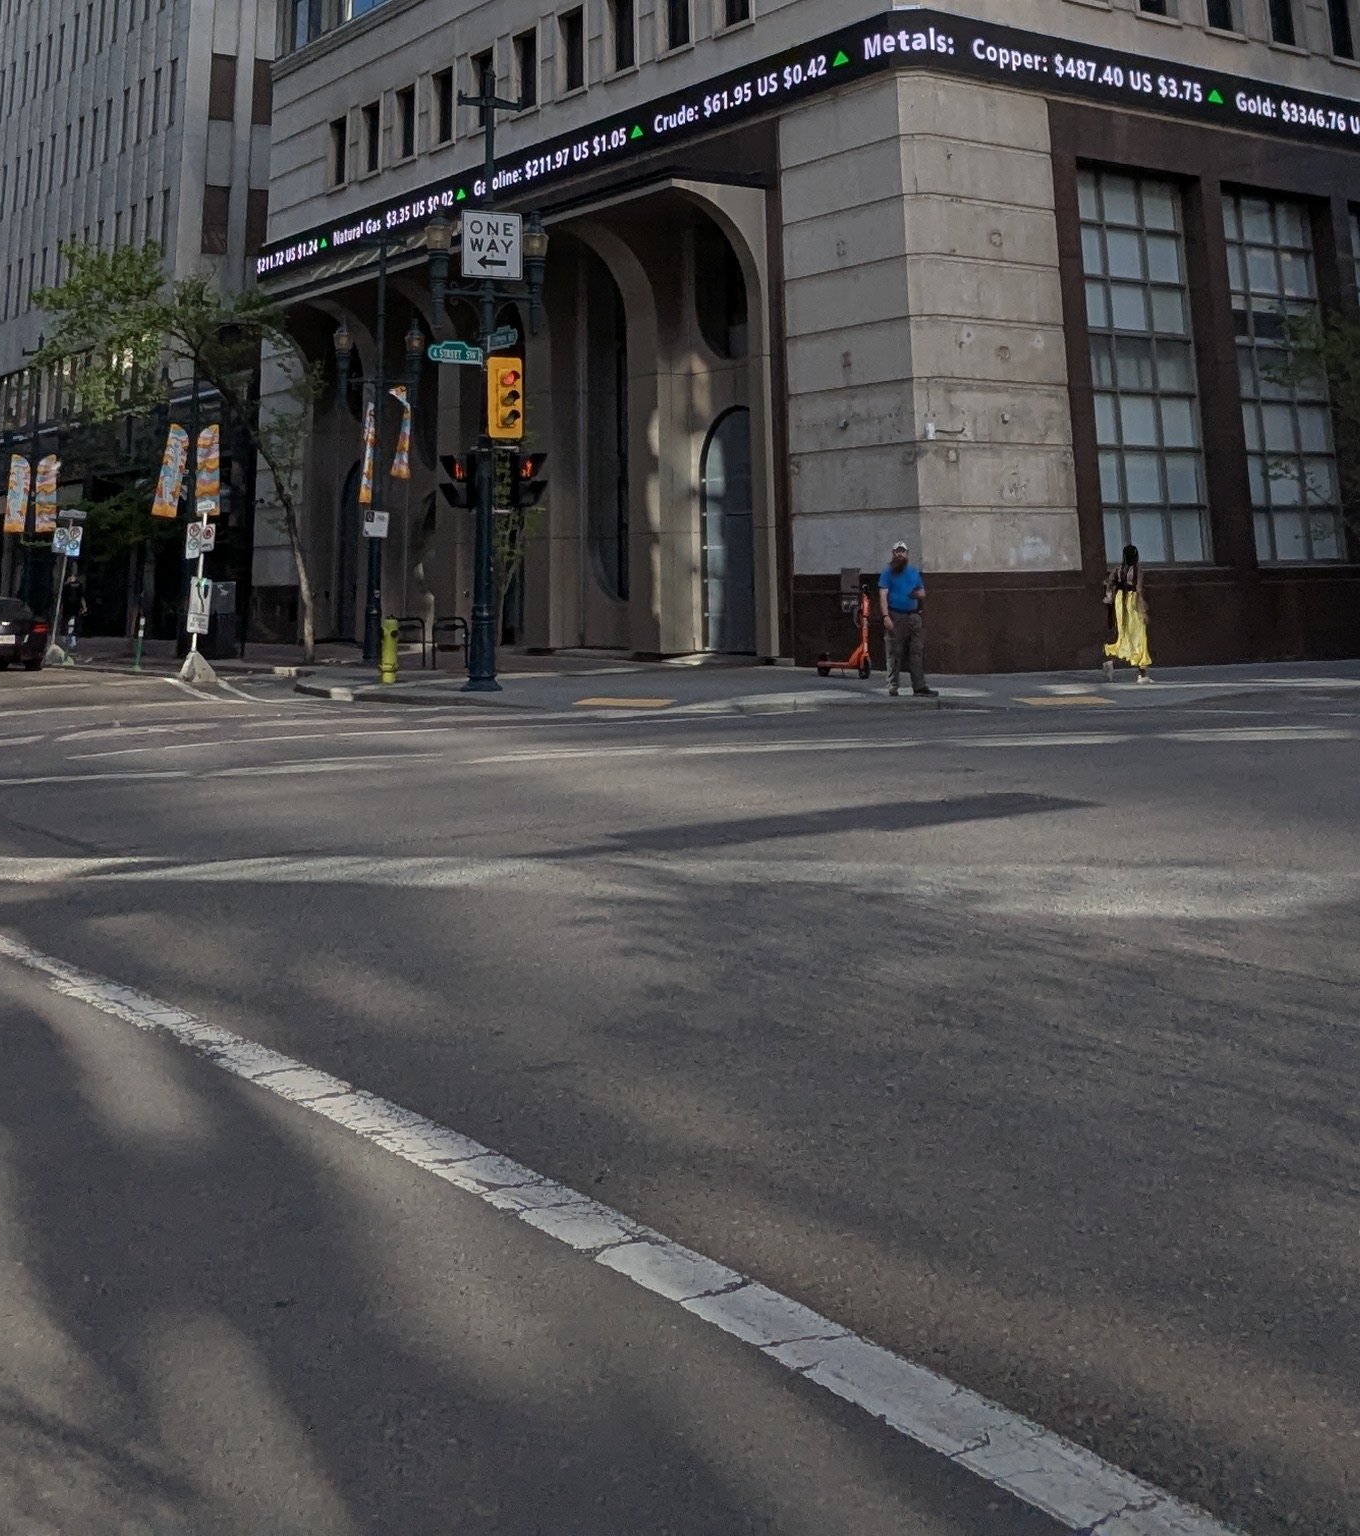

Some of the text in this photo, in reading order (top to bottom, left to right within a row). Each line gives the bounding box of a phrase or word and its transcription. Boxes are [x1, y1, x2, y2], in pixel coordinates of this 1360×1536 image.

[286, 247, 296, 263] US
[297, 239, 318, 259] $1.24
[333, 222, 363, 247] Natural
[386, 206, 410, 229] $3.35
[412, 200, 425, 218] US
[428, 190, 453, 214] $002
[474, 168, 522, 196] Gaoline:
[525, 147, 569, 181] $211.97
[573, 141, 589, 162] US
[592, 127, 626, 156] $1.05
[654, 104, 699, 133] Crude:
[704, 82, 752, 118] $61.95
[757, 73, 778, 96] US
[783, 55, 827, 90] $0.42
[863, 27, 955, 61] Metals:
[972, 38, 1048, 73] Copper:
[1054, 53, 1123, 88] $487.40
[1129, 70, 1152, 93] US
[1157, 75, 1202, 103] $3.75
[1235, 91, 1277, 118] Gold:
[1281, 99, 1346, 131] $3346.76
[470, 220, 514, 237] ONE
[470, 237, 514, 254] WAY
[440, 349, 462, 359] STREET
